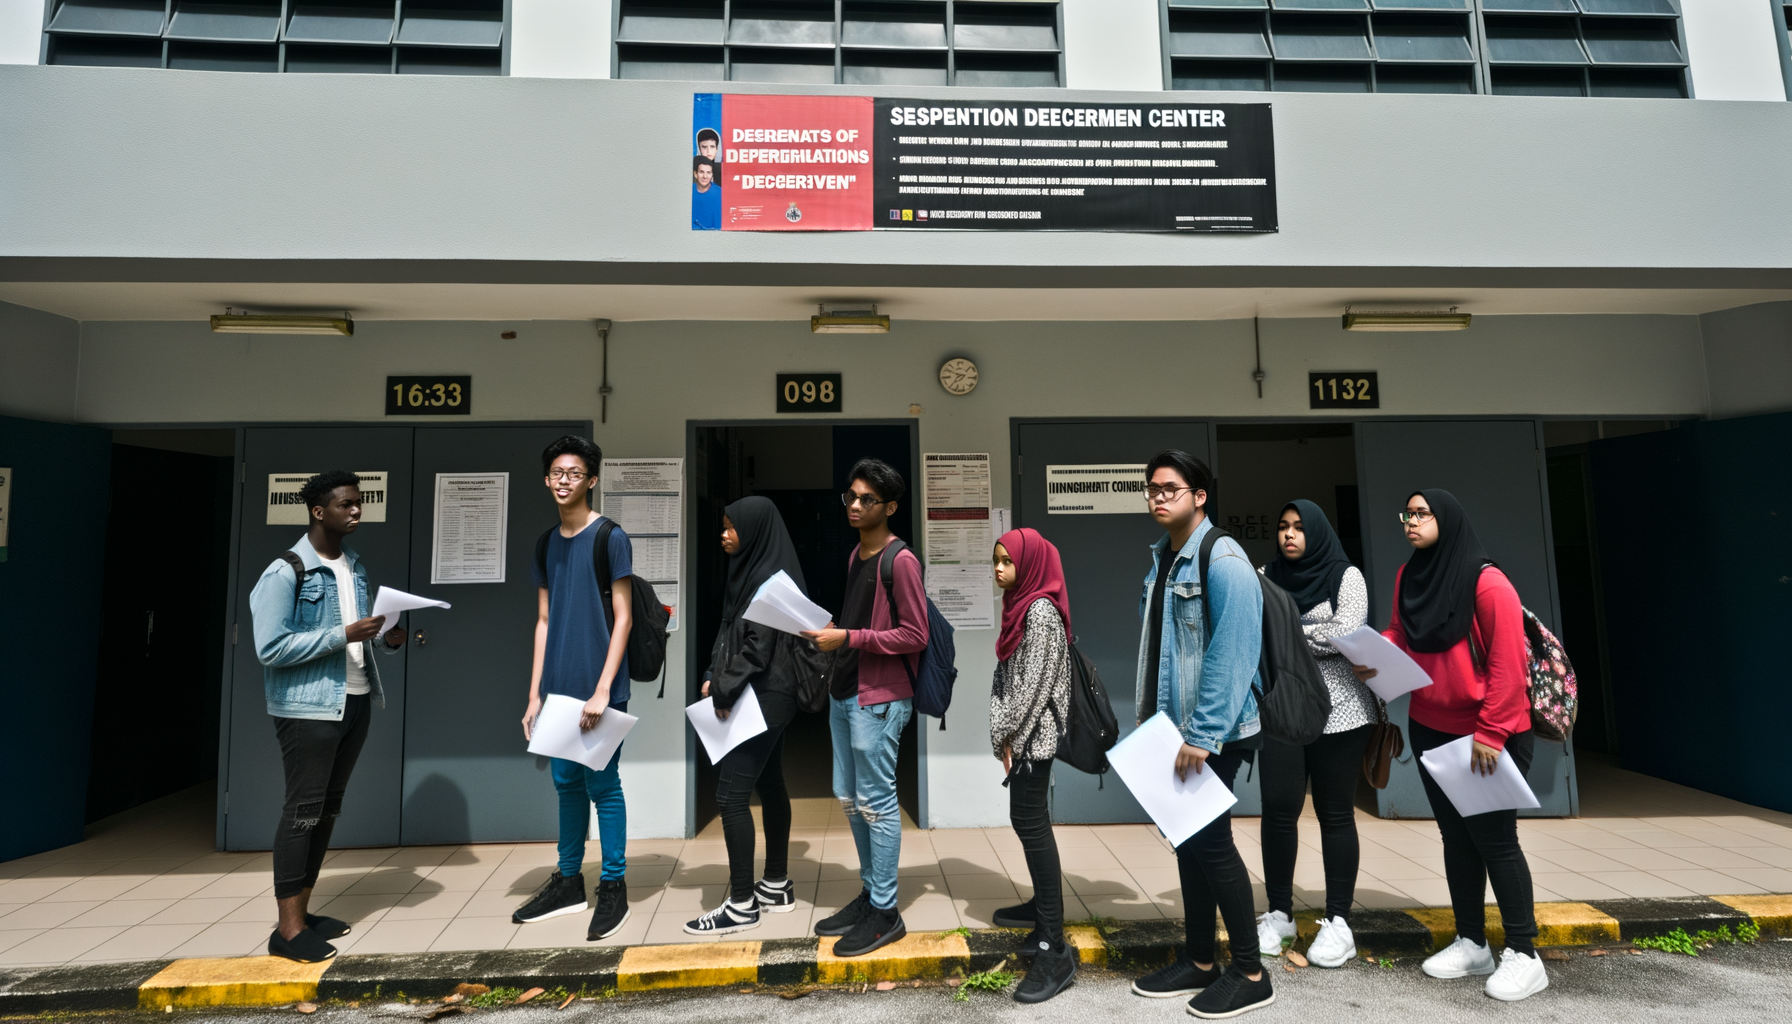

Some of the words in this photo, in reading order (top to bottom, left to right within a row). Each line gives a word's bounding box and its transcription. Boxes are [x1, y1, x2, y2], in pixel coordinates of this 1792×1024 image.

[890, 107, 1018, 126] SESPENTION
[1025, 108, 1142, 127] DEECERMEN
[1148, 109, 1226, 127] CENTER
[835, 128, 859, 143] OF
[394, 383, 462, 407] 16:33
[784, 380, 835, 404] 098
[1315, 379, 1371, 400] 1132
